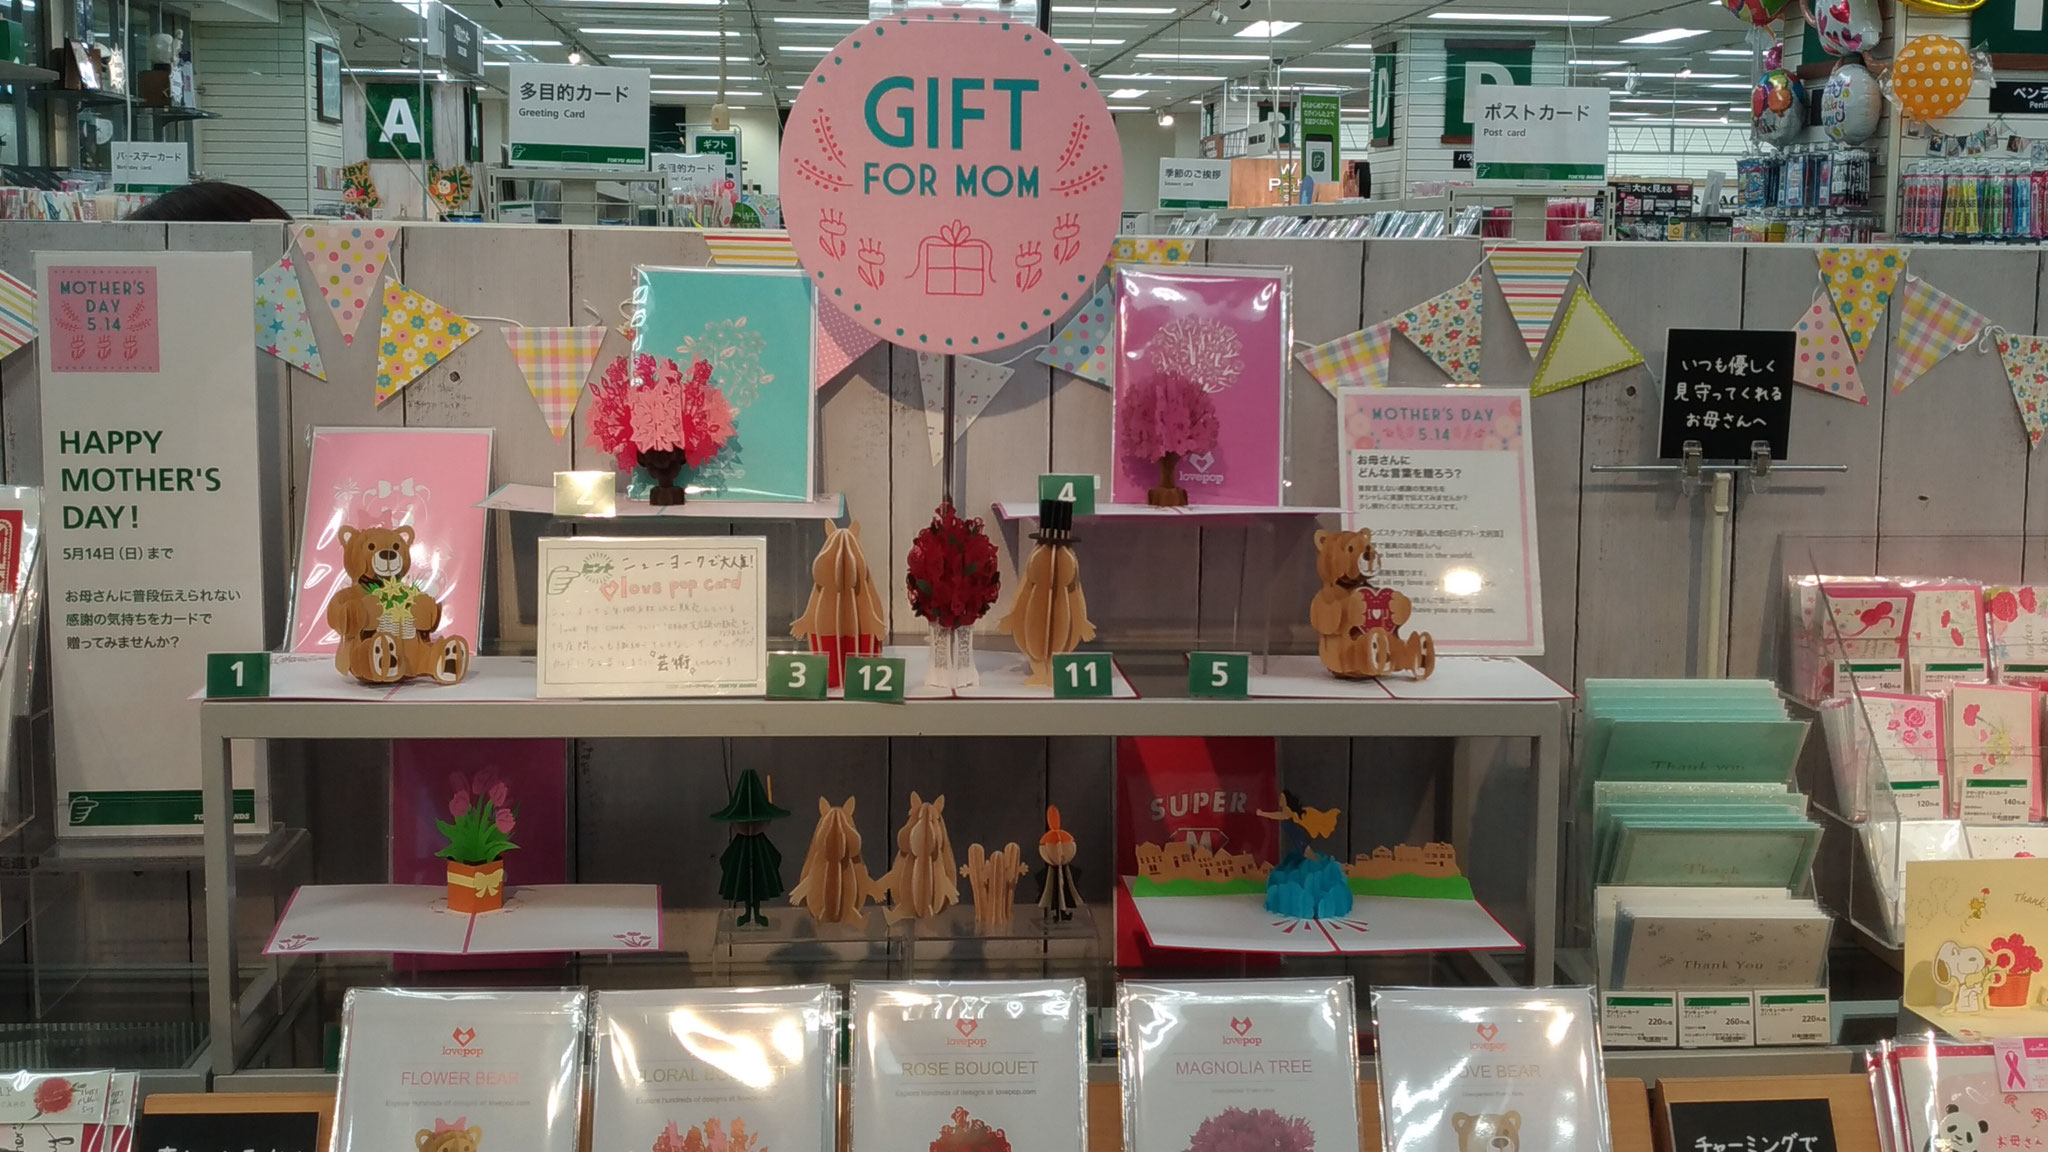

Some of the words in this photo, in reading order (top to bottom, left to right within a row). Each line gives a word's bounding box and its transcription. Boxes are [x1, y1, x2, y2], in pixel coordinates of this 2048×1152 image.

[520, 82, 629, 103] 多目的カード
[1377, 67, 1389, 128] D
[518, 108, 559, 119] Greeting
[564, 109, 585, 119] Card
[864, 76, 1039, 151] GIFT
[1484, 103, 1590, 121] ポストカード
[379, 98, 421, 143] A
[1483, 128, 1503, 136] Post
[1507, 128, 1526, 137] card
[703, 140, 728, 149] ギフト
[864, 162, 937, 196] FOR
[956, 164, 1039, 198] MOM
[1165, 168, 1221, 180] 季節のご挨拶
[60, 281, 145, 295] MOTHER'S
[86, 299, 121, 313] DAY
[1682, 355, 1775, 376] いつも優しく
[1674, 382, 1782, 402] 見守ってくれる
[1372, 408, 1454, 421] MOTHER'S
[1462, 408, 1494, 421] DAY
[1686, 411, 1767, 430] お母さんへ
[60, 430, 163, 454] HAPPY
[1418, 428, 1450, 441] 5.14
[1357, 455, 1410, 466] お母さんに
[61, 467, 221, 492] MOTHER'S
[1179, 472, 1223, 484] lovepop
[1058, 482, 1076, 502] 4
[63, 505, 139, 529] DAY!
[621, 576, 662, 598] love
[669, 579, 698, 599] pop
[703, 571, 742, 591] card
[65, 589, 241, 603] お母さんに普段伝えられない
[65, 612, 213, 626] 感謝の気持ちをカードで
[230, 661, 244, 687] 1
[788, 662, 806, 688] 3
[858, 666, 893, 692] 12
[1065, 662, 1097, 687] 11
[1211, 662, 1228, 687] 5
[1150, 791, 1248, 821] SUPER
[2015, 892, 2046, 908] Thank
[1683, 960, 1728, 969] Thank
[1736, 960, 1764, 970] You
[947, 1037, 987, 1047] lovepop
[1222, 1036, 1262, 1046] lovepop
[442, 1046, 484, 1057] lovepop
[902, 1062, 949, 1076] ROSE
[955, 1061, 1039, 1076] BOUQUET
[1176, 1061, 1264, 1075] MAGNOLIA
[1269, 1060, 1312, 1074] TREE
[1497, 1064, 1541, 1078] BEAR
[401, 1071, 470, 1086] FLOWER
[475, 1071, 520, 1085] BEAR
